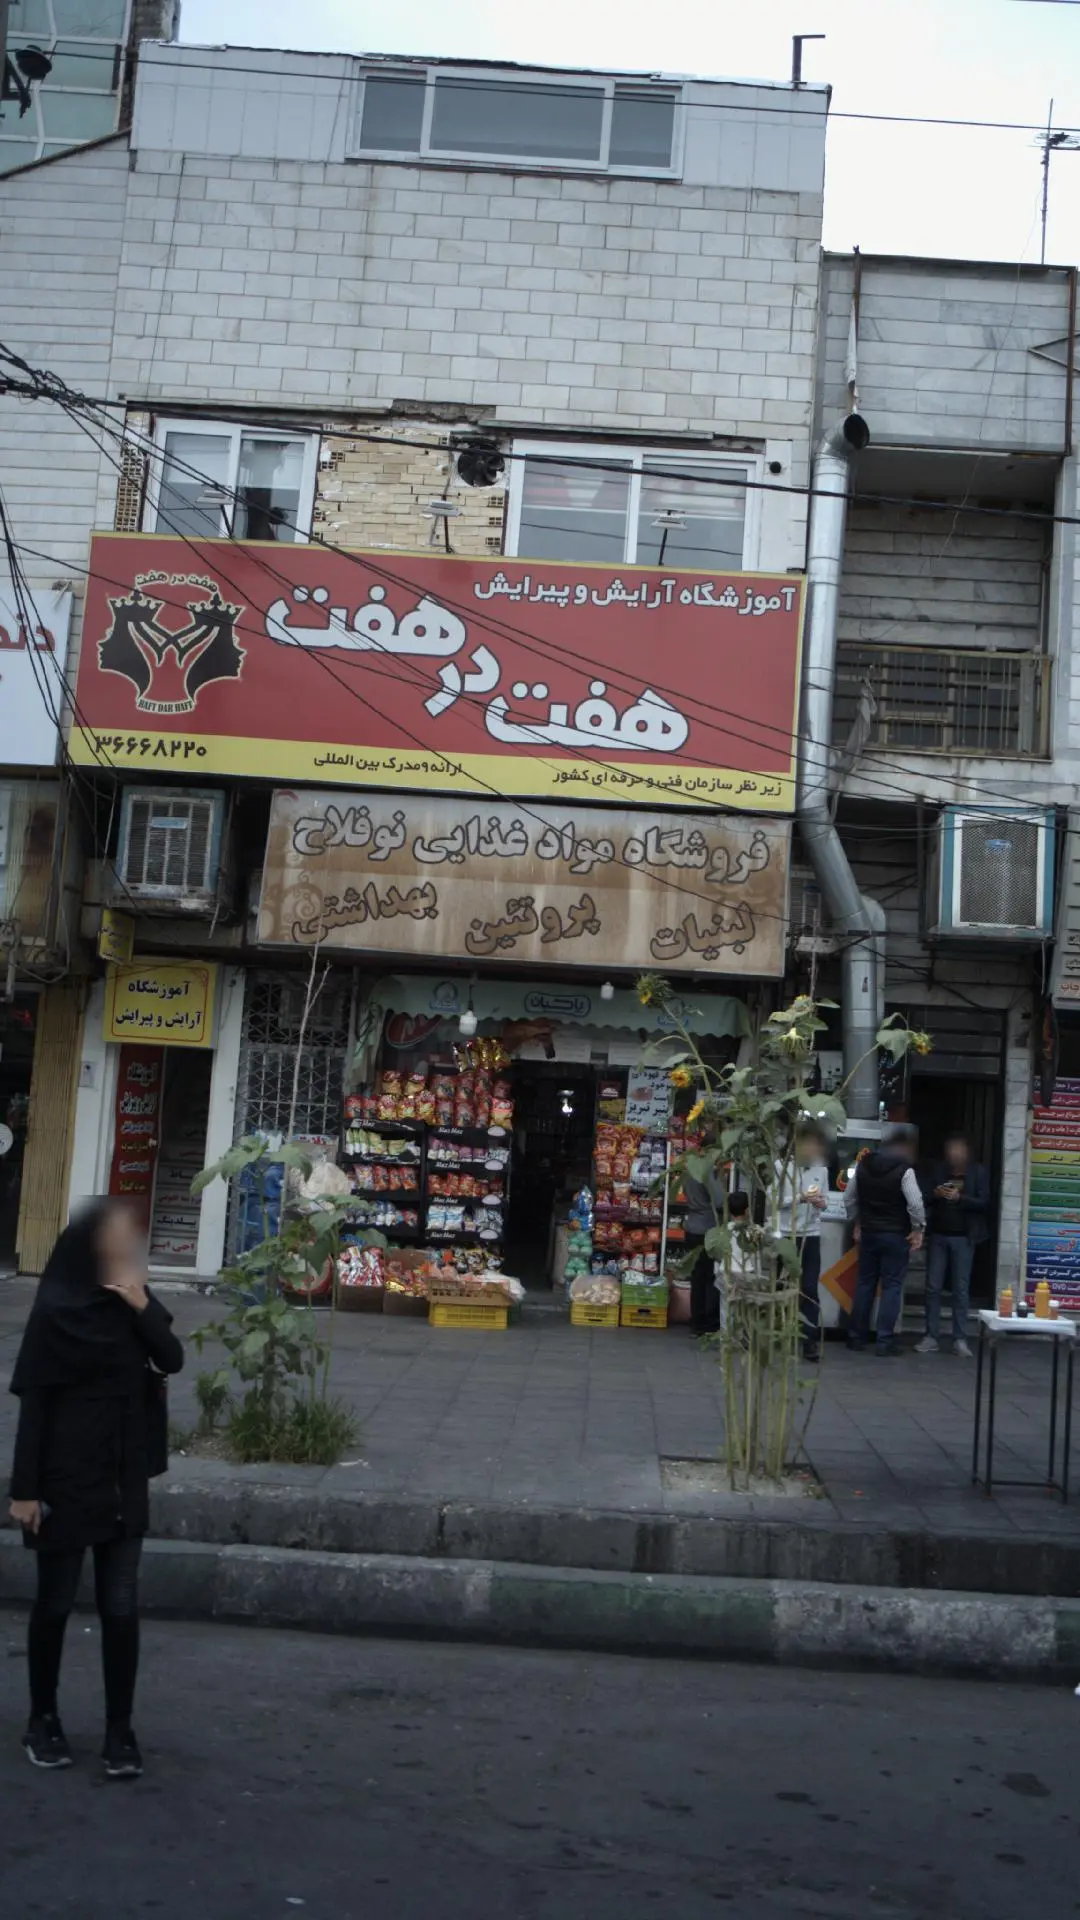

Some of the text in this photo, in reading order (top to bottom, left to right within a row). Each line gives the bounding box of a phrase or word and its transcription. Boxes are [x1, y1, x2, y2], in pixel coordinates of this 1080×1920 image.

[136, 571, 218, 592] هفت در هفت
[473, 571, 796, 616] آموزشگاه آرایش و پیرایش
[264, 584, 690, 752] هفت در هفت
[138, 698, 194, 713] HAFT DAR HAFT
[314, 752, 354, 767] المللی
[552, 767, 589, 783] کشور
[591, 771, 608, 786] ای
[656, 773, 682, 789] فنی
[684, 777, 733, 792] سازمان
[735, 780, 757, 794] نظر
[760, 782, 782, 796] زیر
[412, 814, 529, 865] غذایی
[535, 820, 616, 875] مواد
[622, 825, 771, 884] فروشگاه
[291, 881, 757, 961] لبنیات پروتئین بهداشتی
[128, 979, 191, 999] آموزشگاه
[115, 1008, 153, 1027] پیرایش
[165, 1011, 202, 1029] آرایش
